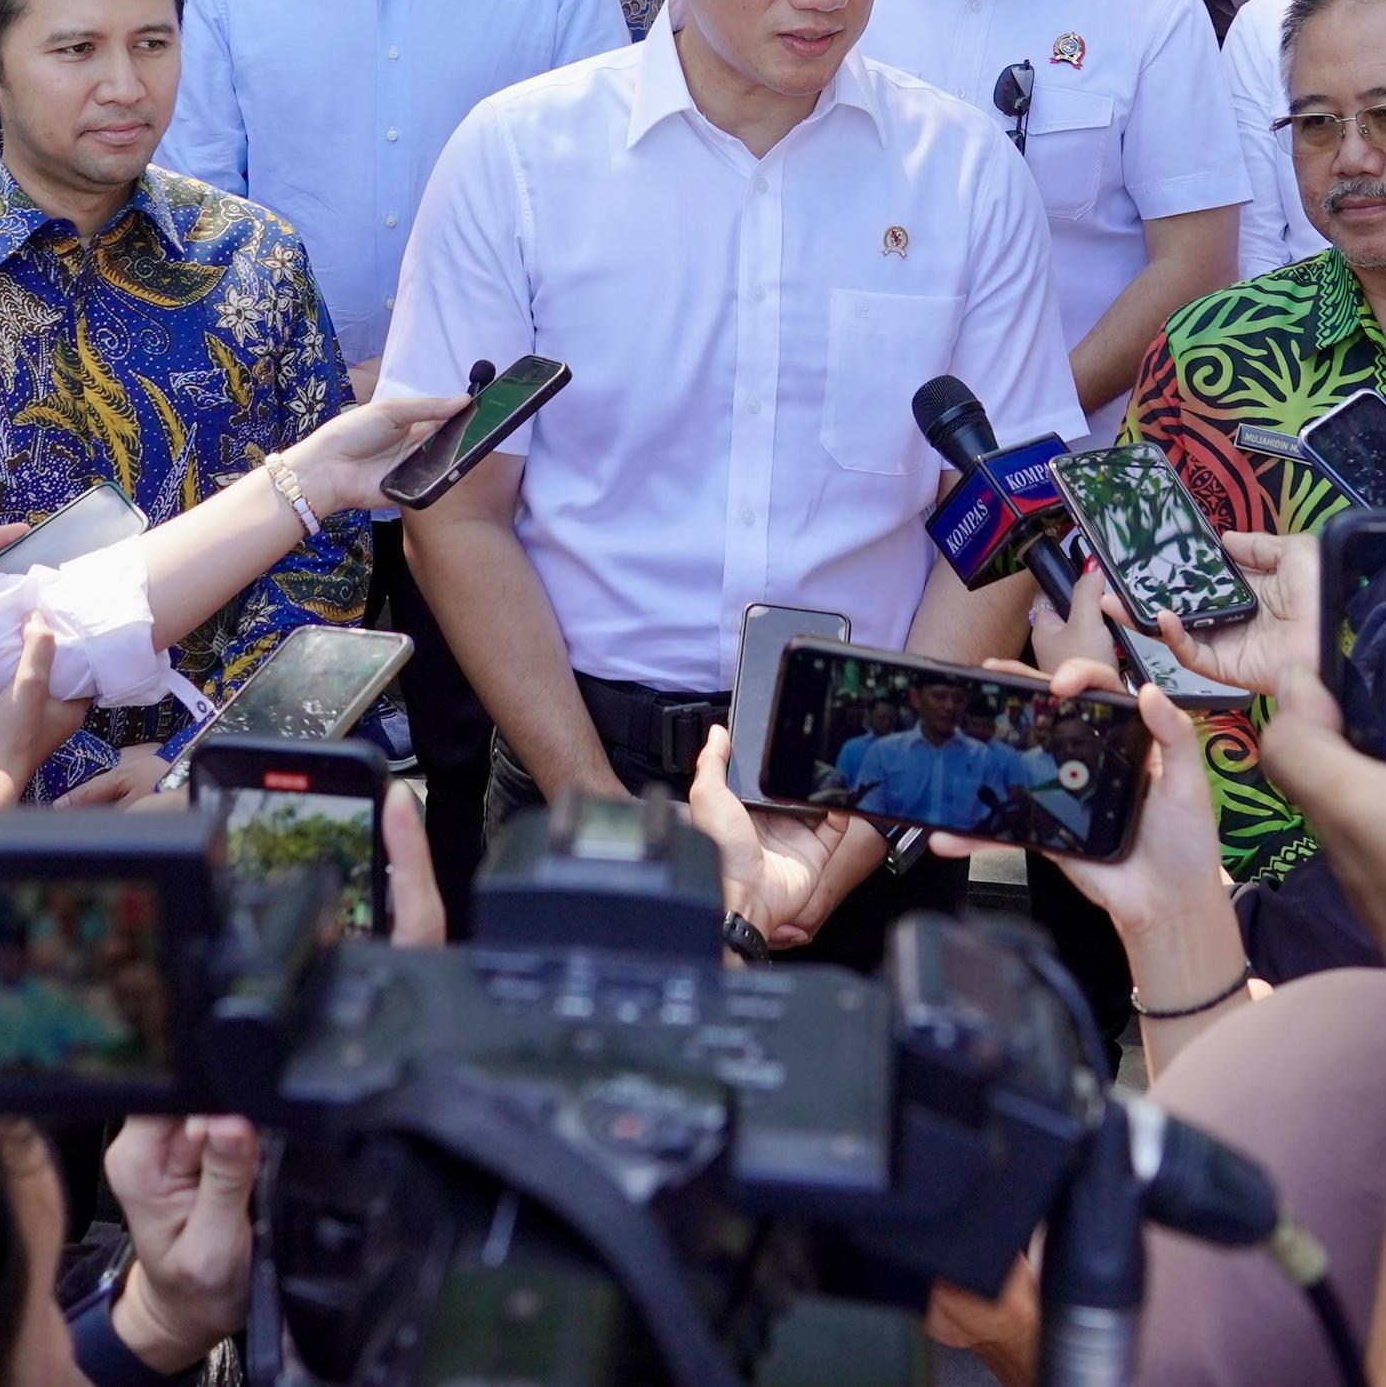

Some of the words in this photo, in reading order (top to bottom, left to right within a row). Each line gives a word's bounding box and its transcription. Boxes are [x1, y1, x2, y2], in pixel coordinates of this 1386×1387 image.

[1244, 433, 1289, 450] MUJAHIDIN
[1005, 462, 1050, 491] KOMPA
[946, 498, 989, 555] KOMPAS
